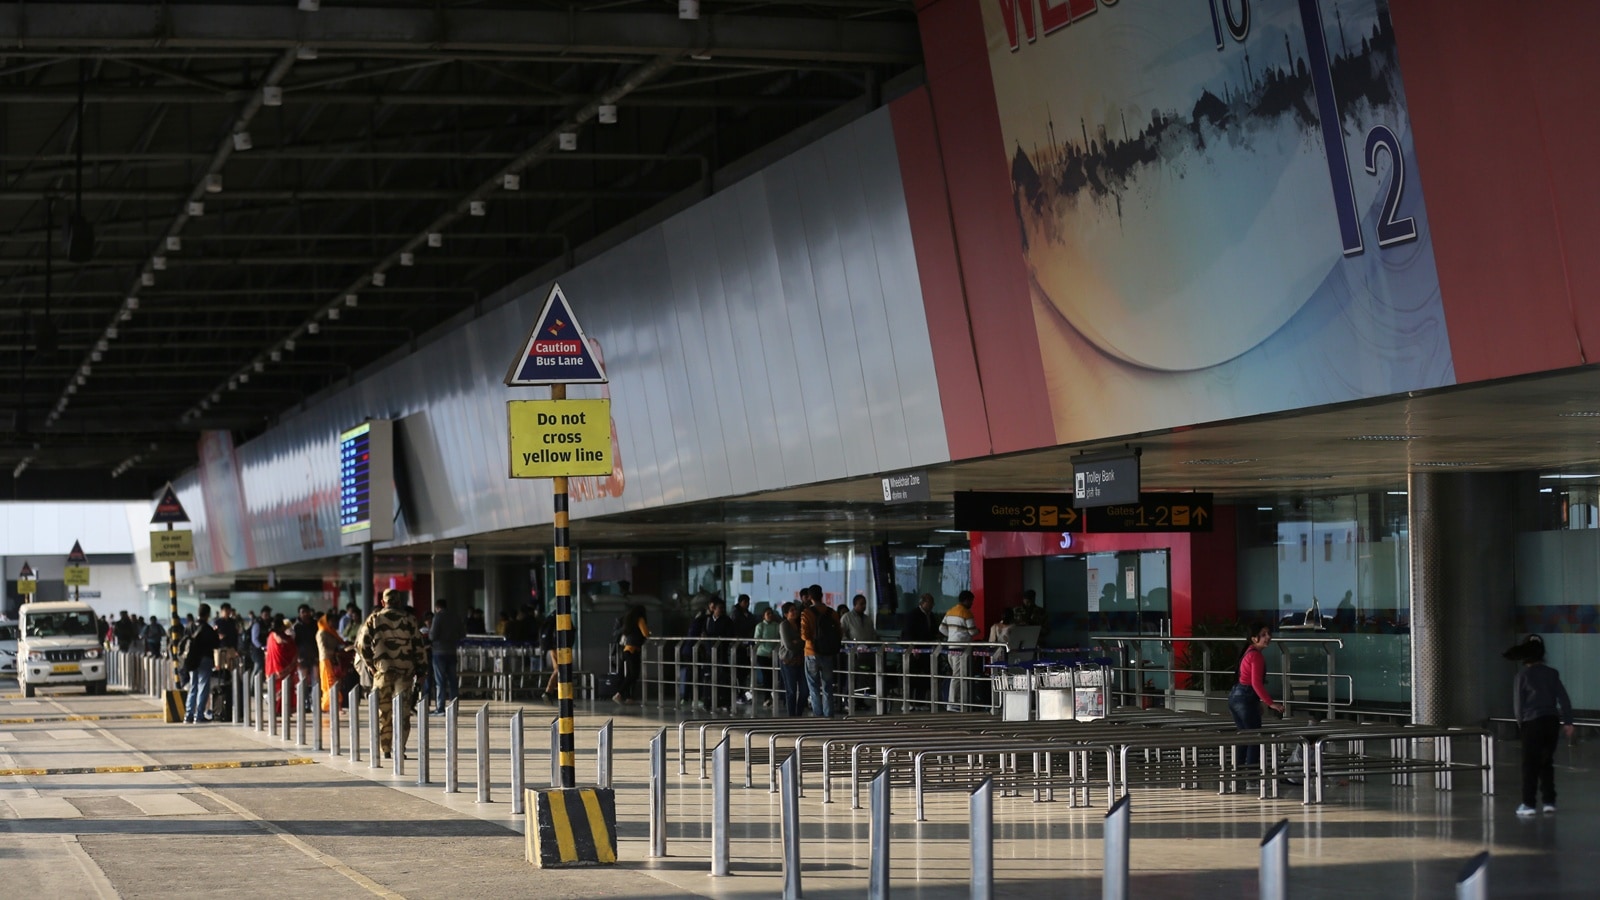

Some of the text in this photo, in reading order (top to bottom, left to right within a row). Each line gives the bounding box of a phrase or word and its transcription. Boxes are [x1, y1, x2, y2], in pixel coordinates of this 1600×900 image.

[535, 342, 577, 353] Caution
[536, 355, 584, 366] Bus Lane
[537, 412, 586, 425] Do not
[542, 432, 582, 444] cross
[522, 448, 603, 465] yellow line
[909, 474, 920, 485] Zone
[1085, 469, 1115, 485] Trolley Bank
[991, 505, 1021, 515] Gates
[1022, 505, 1036, 526] 3
[1106, 506, 1135, 515] Gates
[1135, 506, 1169, 526] 1-2
